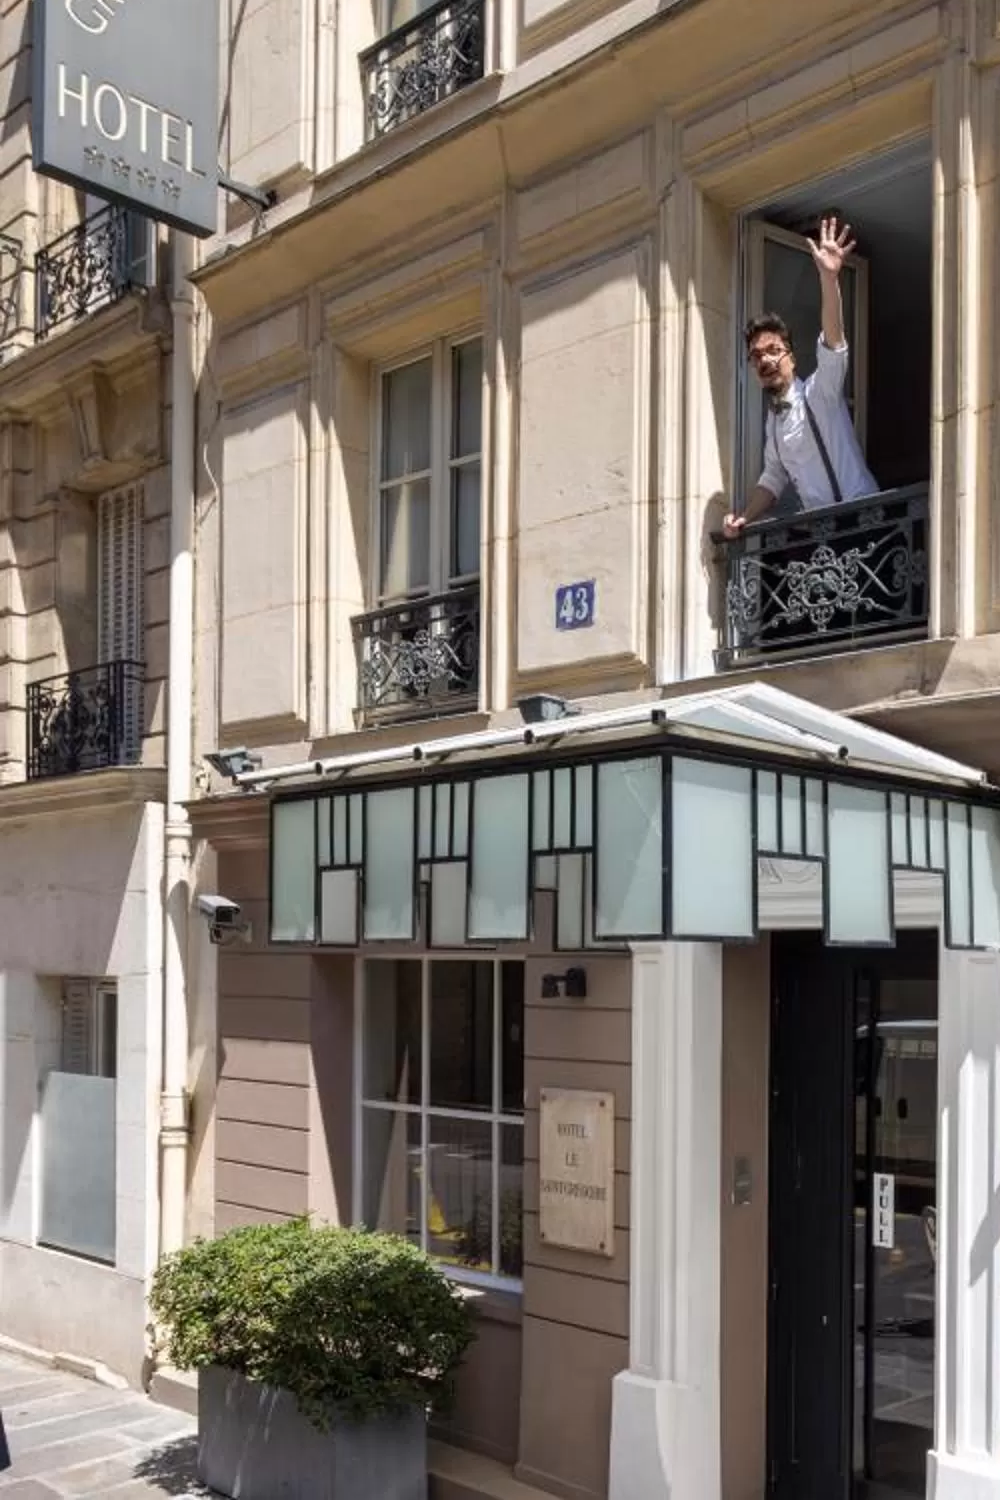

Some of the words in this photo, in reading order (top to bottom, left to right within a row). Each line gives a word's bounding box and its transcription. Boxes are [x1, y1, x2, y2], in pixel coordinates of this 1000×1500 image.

[57, 62, 208, 178] HOTEL
[560, 587, 589, 622] 43
[878, 1177, 890, 1244] PULL
